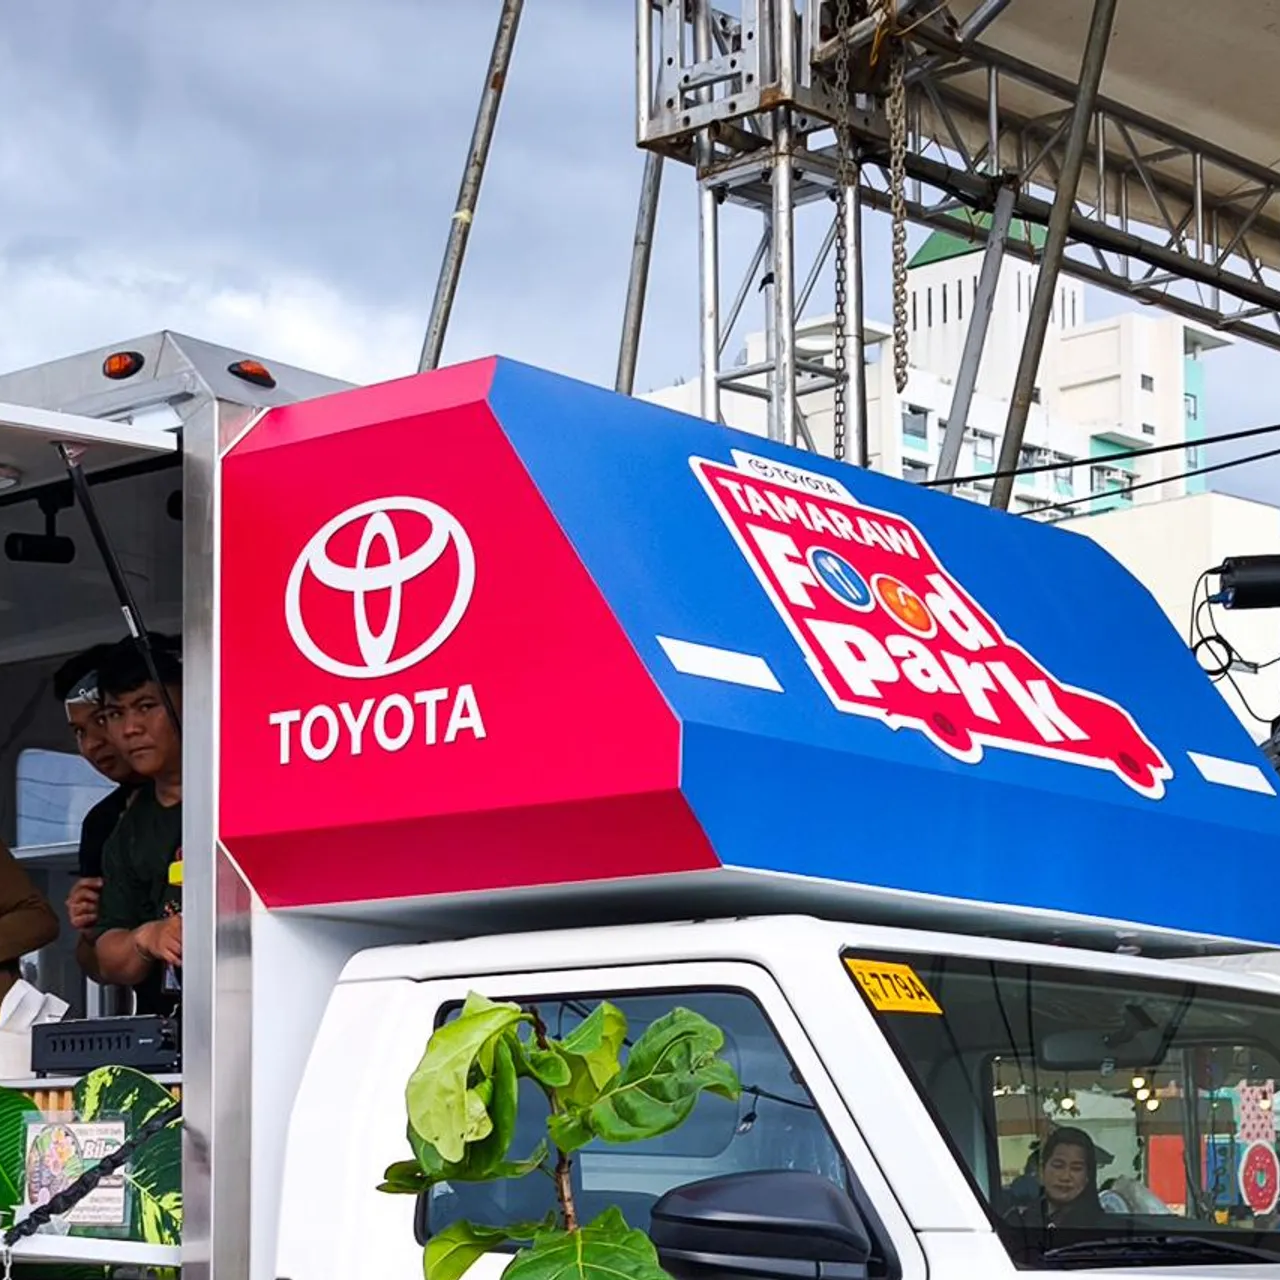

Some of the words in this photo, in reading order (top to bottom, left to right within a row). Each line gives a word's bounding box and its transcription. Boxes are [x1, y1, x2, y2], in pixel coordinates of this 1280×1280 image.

[715, 477, 920, 560] TAMARAW
[772, 466, 842, 497] TOYOTA
[268, 683, 487, 765] TOYOTA
